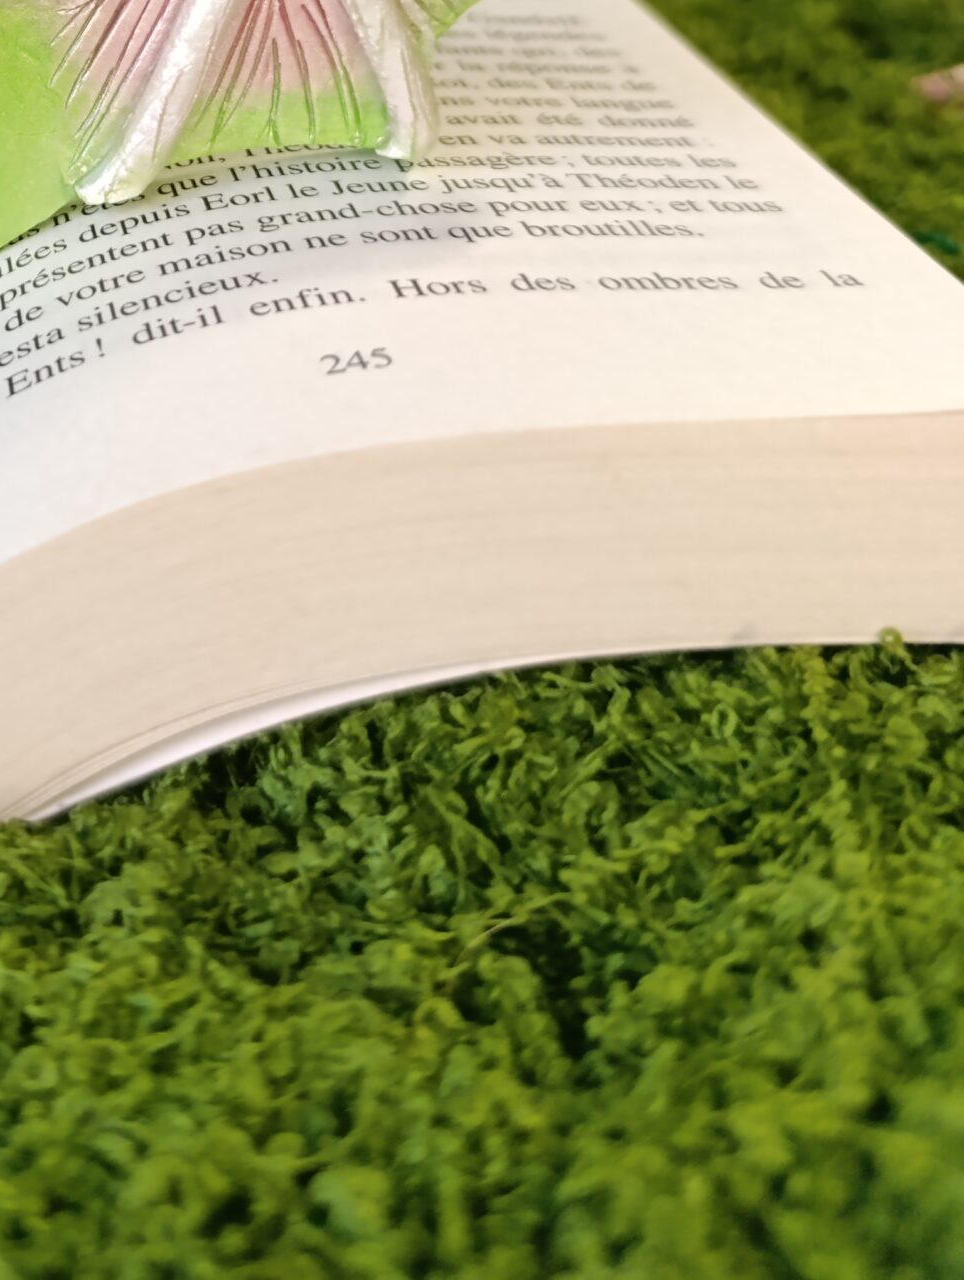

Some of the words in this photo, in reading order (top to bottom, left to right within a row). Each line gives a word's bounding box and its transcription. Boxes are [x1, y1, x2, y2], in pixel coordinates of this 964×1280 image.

[438, 133, 478, 147] en
[487, 134, 526, 147] va
[535, 132, 697, 149] autrement
[445, 111, 520, 126] avait
[536, 112, 584, 126] été
[156, 173, 219, 199] que
[227, 156, 383, 183] l'histoire
[581, 152, 683, 169] toutes
[686, 152, 737, 169] les
[78, 202, 192, 244] depuis
[201, 185, 277, 213] Eorl
[288, 183, 321, 200] le
[330, 178, 430, 197] Jeune
[436, 172, 565, 194] jusqu'à
[566, 171, 722, 191] Théoden
[723, 174, 761, 191] le
[185, 218, 245, 246] pas
[257, 198, 478, 233] grand-chose
[486, 198, 571, 218] pour
[668, 198, 707, 213] et
[708, 198, 785, 214] tous
[3, 303, 46, 333] de
[55, 264, 147, 308] votre
[156, 238, 294, 278] maison
[303, 228, 350, 250] ne
[359, 226, 437, 245] sont
[446, 222, 515, 244] que
[518, 218, 706, 238] broutilles.
[77, 269, 280, 333] silencieux.
[131, 303, 225, 346] dit-il
[248, 286, 367, 317] enfin.
[387, 276, 488, 299] Hors
[509, 272, 577, 293] des
[597, 271, 741, 292] ombres
[757, 270, 807, 290] de
[817, 268, 866, 289] la
[319, 345, 394, 376] 245
